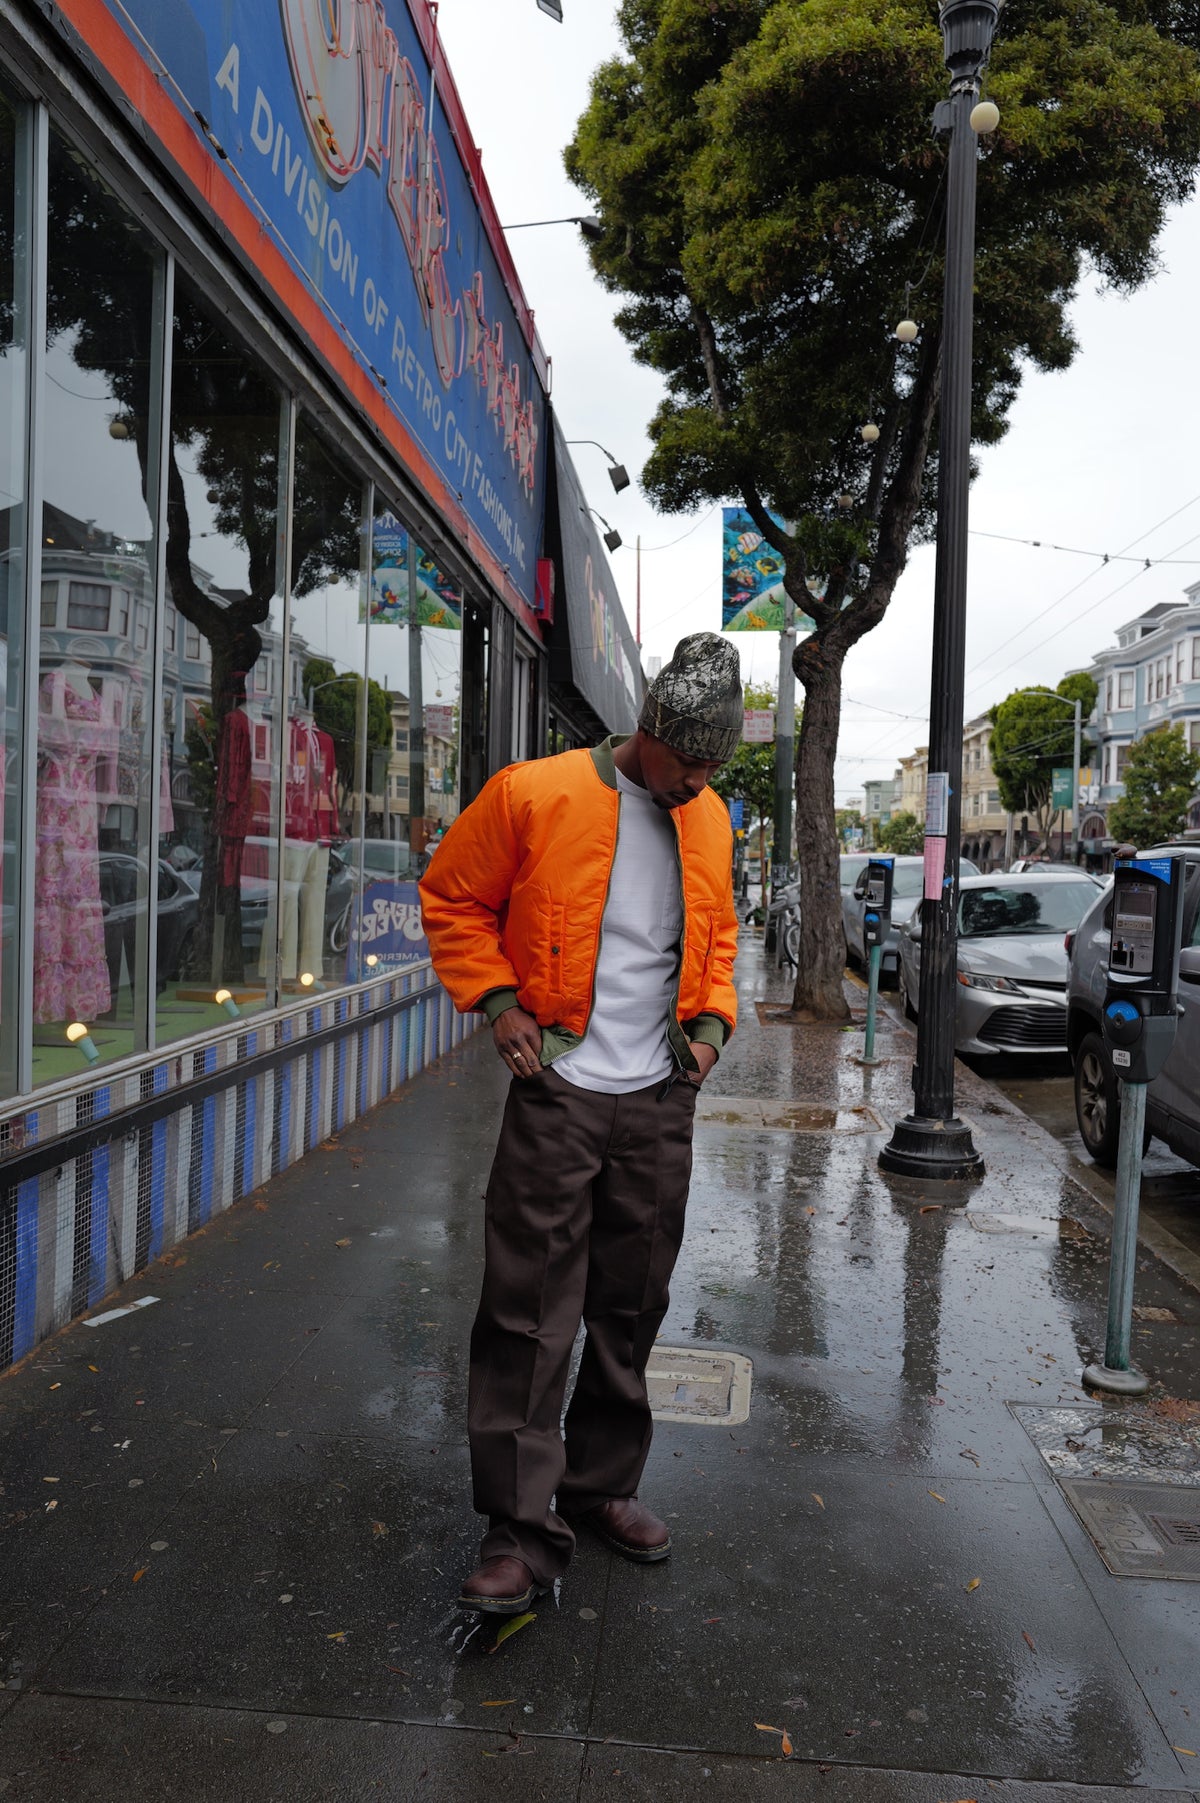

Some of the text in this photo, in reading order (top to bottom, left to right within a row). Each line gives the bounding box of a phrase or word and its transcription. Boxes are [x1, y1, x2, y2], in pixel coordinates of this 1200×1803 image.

[215, 43, 240, 115] A
[250, 85, 359, 297] DIVISION
[363, 278, 389, 336] OF
[391, 315, 442, 432] RETRO
[444, 410, 472, 488] CITY
